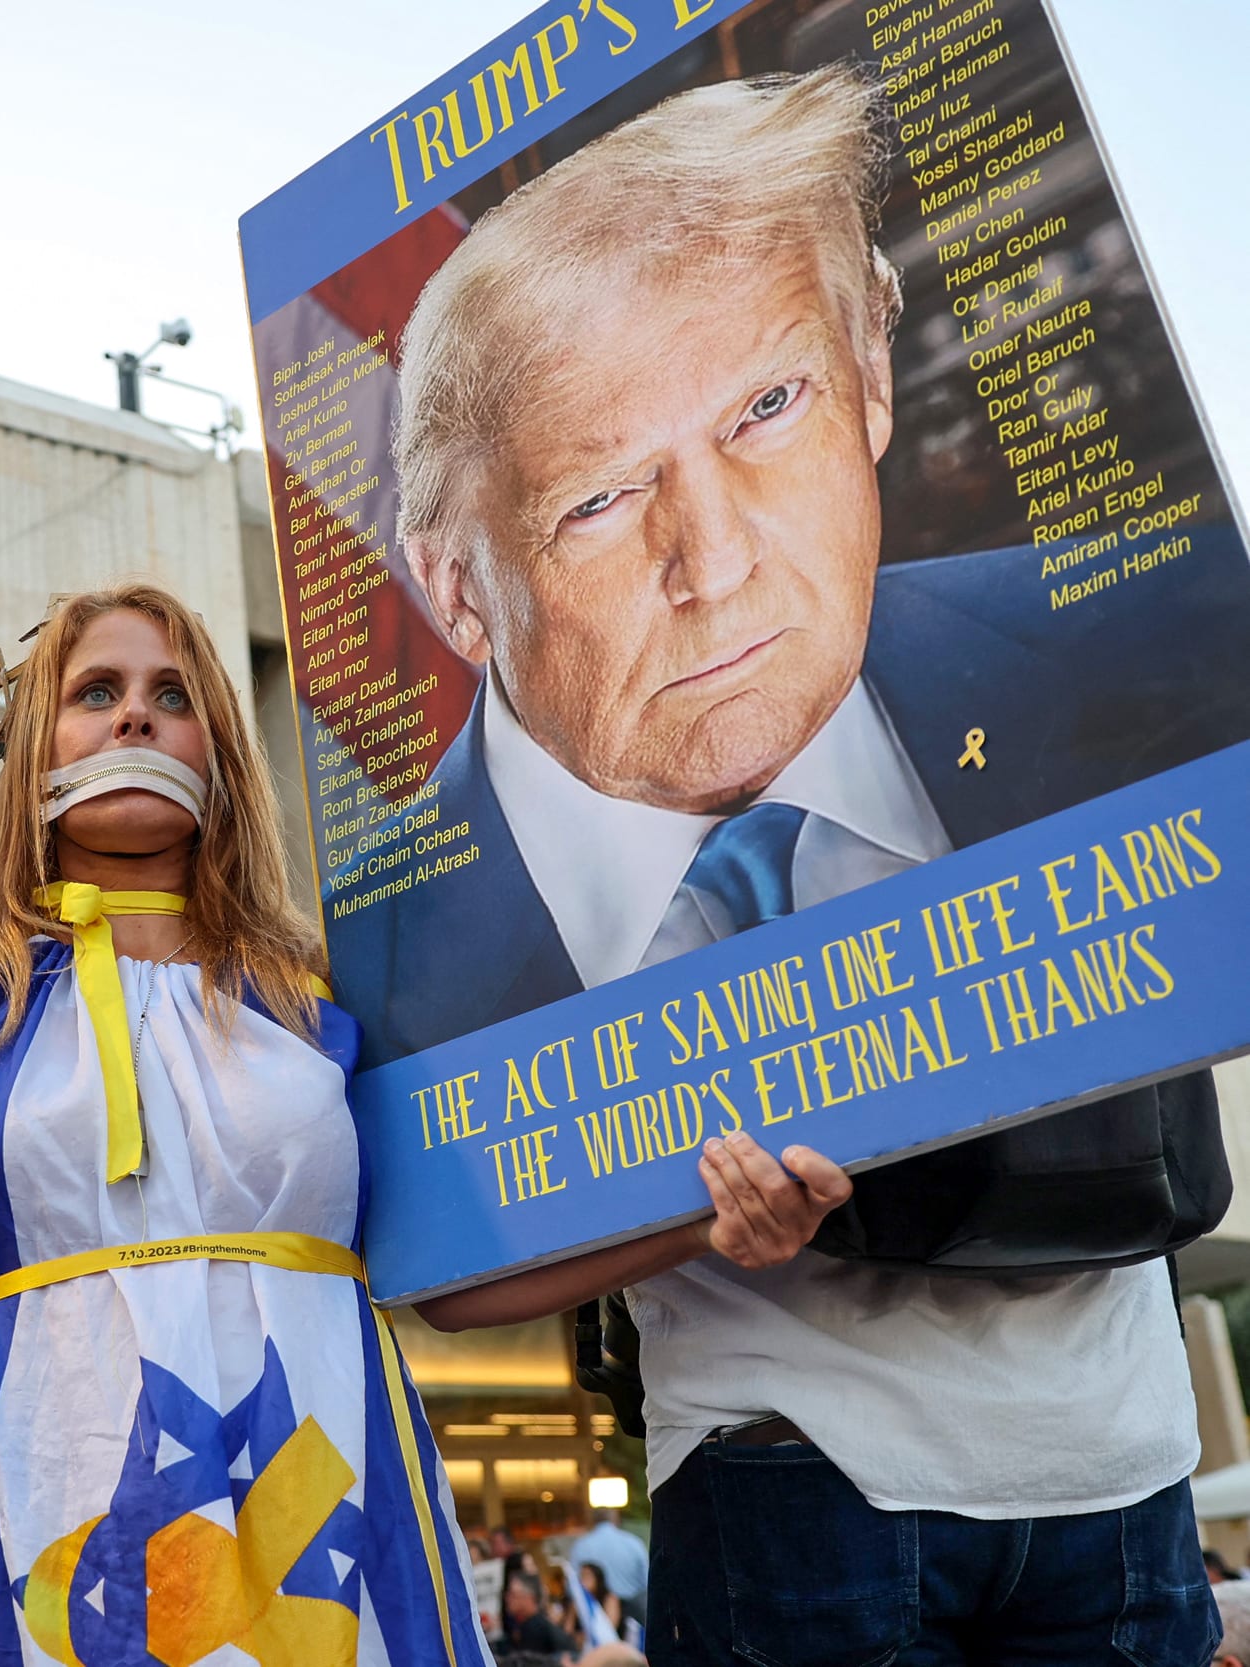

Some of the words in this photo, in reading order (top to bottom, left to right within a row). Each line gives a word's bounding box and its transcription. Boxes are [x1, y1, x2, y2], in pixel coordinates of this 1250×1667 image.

[866, 0, 913, 27] Davi
[872, 4, 933, 50] Eliyahu
[880, 37, 917, 74] Asaf
[922, 0, 994, 48] Hamami
[886, 56, 936, 96] Sahar
[941, 17, 1003, 64] Baruch
[894, 83, 937, 120] Inbar
[942, 42, 1010, 91] Haiman
[369, 0, 637, 214] TRUMP'S
[900, 116, 934, 144] Guy
[940, 92, 971, 122] Iluz
[905, 142, 930, 168] Tal
[935, 104, 996, 152] Chaimi
[912, 152, 958, 190] Yossi
[964, 110, 1033, 162] Sharabi
[920, 173, 980, 216] Manny
[984, 121, 1066, 179] Goddard
[926, 197, 982, 241] Daniel
[988, 167, 1042, 206] Perez
[938, 236, 970, 264] Itay
[975, 206, 1024, 243] Chen
[945, 250, 1001, 291] Hadar
[1006, 214, 1067, 258] Goldin
[953, 292, 980, 317] Oz
[984, 257, 1043, 303] Daniel
[962, 314, 997, 344] Lior
[1002, 276, 1063, 324] Rudaif
[273, 361, 300, 386] Bipin
[304, 337, 334, 368] Joshi
[969, 332, 1021, 371] Omer
[1026, 299, 1092, 343] Nautra
[977, 361, 1021, 397] Oriel
[1027, 326, 1095, 375] Baruch
[274, 365, 333, 407] Sothetisak
[337, 329, 385, 365] Rintelak
[277, 398, 318, 429] Joshua
[322, 376, 350, 407] Luito
[353, 350, 388, 382] Mollel
[988, 389, 1029, 421] Dror
[1034, 373, 1059, 397] Or
[285, 422, 310, 446] Ariel
[314, 400, 347, 425] Kunio
[286, 448, 302, 468] Ziv
[306, 420, 351, 454] Berman
[998, 414, 1037, 444] Ran
[1043, 385, 1093, 421] Guily
[1004, 432, 1057, 469] Tamir
[1061, 407, 1108, 444] Adar
[285, 469, 307, 491] Gali
[311, 440, 357, 475] Berman
[289, 469, 346, 512] Avinathan
[351, 458, 366, 476] Or
[1016, 459, 1066, 496] Eitan
[1071, 435, 1119, 470] Levy
[1027, 487, 1070, 522] Ariel
[1075, 459, 1134, 498] Kunio
[290, 514, 311, 535] Bar
[315, 475, 379, 521] Kuperstein
[294, 529, 322, 556] Omri
[326, 510, 359, 540] Miran
[1033, 506, 1098, 549] Ronen
[1104, 472, 1164, 517] Engel
[1041, 532, 1117, 579] Amiram
[1123, 493, 1201, 540] Cooper
[294, 552, 326, 580] Tamir
[330, 523, 377, 557] Nimrodi
[300, 574, 336, 602] Matan
[341, 544, 387, 581] angrest
[1051, 568, 1117, 611] Maxim
[1122, 535, 1191, 579] Harkin
[300, 589, 343, 626] Nimrod
[348, 569, 389, 599] Cohen
[303, 625, 333, 649] Eitan
[338, 605, 368, 631] Horn
[307, 649, 335, 672] Alon
[339, 627, 369, 656] Ohel
[310, 673, 340, 697] Eitan
[345, 654, 369, 679] mor
[313, 691, 356, 724] Eviatar
[360, 668, 396, 698] David
[314, 719, 350, 746] Aryeh
[355, 673, 438, 726] Zalmanovich
[318, 744, 357, 771] Segev
[361, 709, 424, 750] Chalphon
[320, 765, 362, 796] Elkana
[367, 727, 438, 774] Boochboot
[323, 795, 352, 821] Rom
[357, 759, 428, 803] Breslavsky
[325, 815, 364, 844] Matan
[369, 781, 440, 826] Zangauker
[328, 848, 353, 869] Guy
[358, 824, 400, 854] Gilboa
[404, 803, 439, 833] Dalal
[328, 866, 364, 892] Yosef
[368, 846, 410, 876] Chaim
[415, 821, 469, 851] Ochana
[334, 870, 412, 920] Muhammad
[415, 844, 479, 883] Al-Atrash
[410, 1071, 487, 1151] THE
[503, 1036, 580, 1123] ACT
[594, 1012, 644, 1092] OF
[660, 955, 818, 1066] SAVING
[822, 919, 915, 1009] ONE
[922, 875, 1036, 974] LIFE
[1039, 808, 1223, 935] EARNS
[485, 1125, 567, 1208] THE
[575, 1068, 743, 1179] WORLD'S
[751, 996, 969, 1127] ETERNAL
[965, 924, 1176, 1054] THANKS
[118, 1246, 181, 1260] 7.10.2023
[183, 1245, 267, 1257] #Bringthemhome
